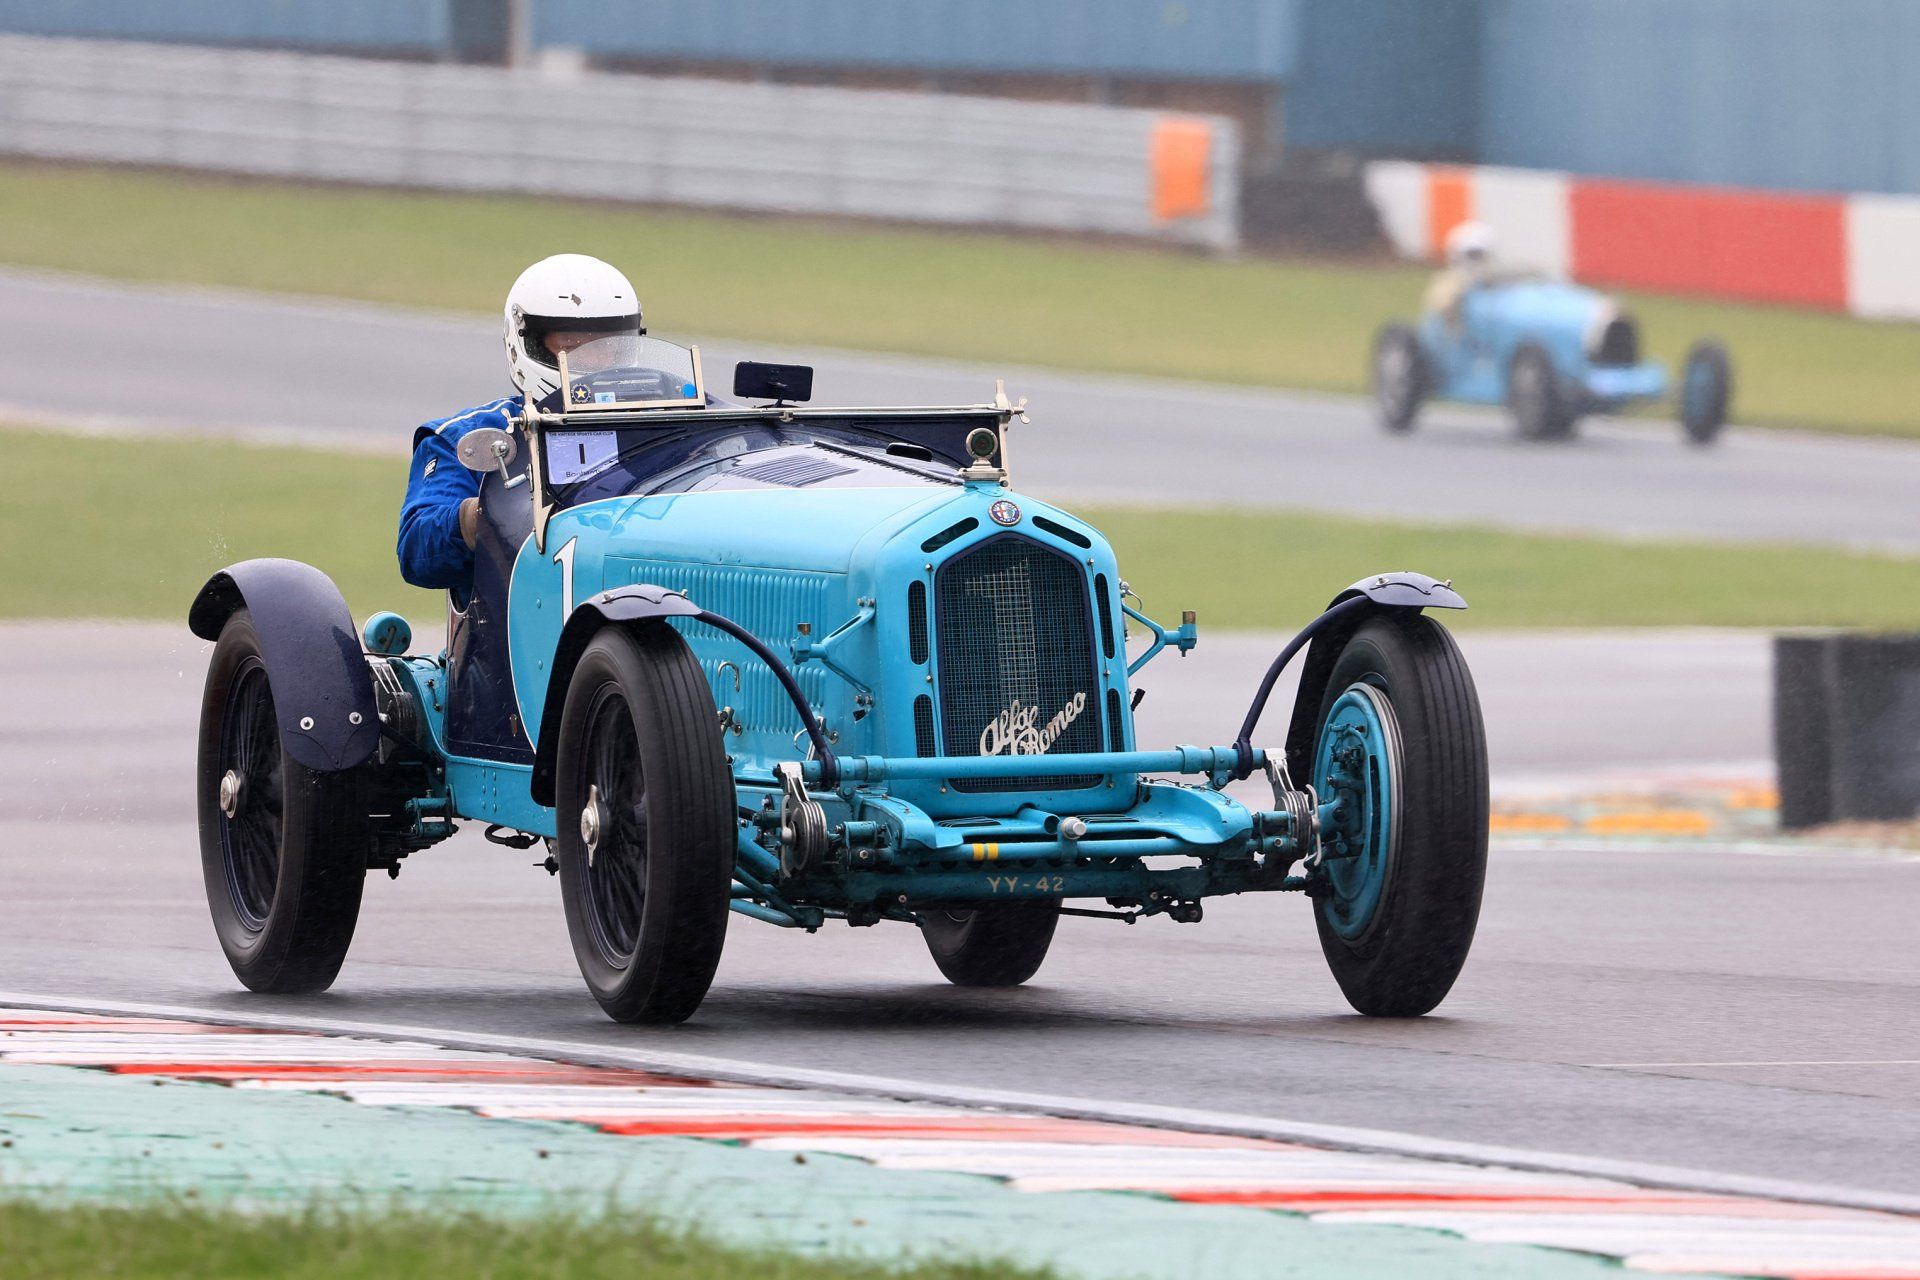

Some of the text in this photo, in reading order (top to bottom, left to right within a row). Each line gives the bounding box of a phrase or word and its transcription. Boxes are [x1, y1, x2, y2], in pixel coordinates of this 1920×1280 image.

[553, 535, 578, 627] 1
[980, 692, 1086, 757] Alfa Romeo
[986, 876, 1064, 893] YY-42
